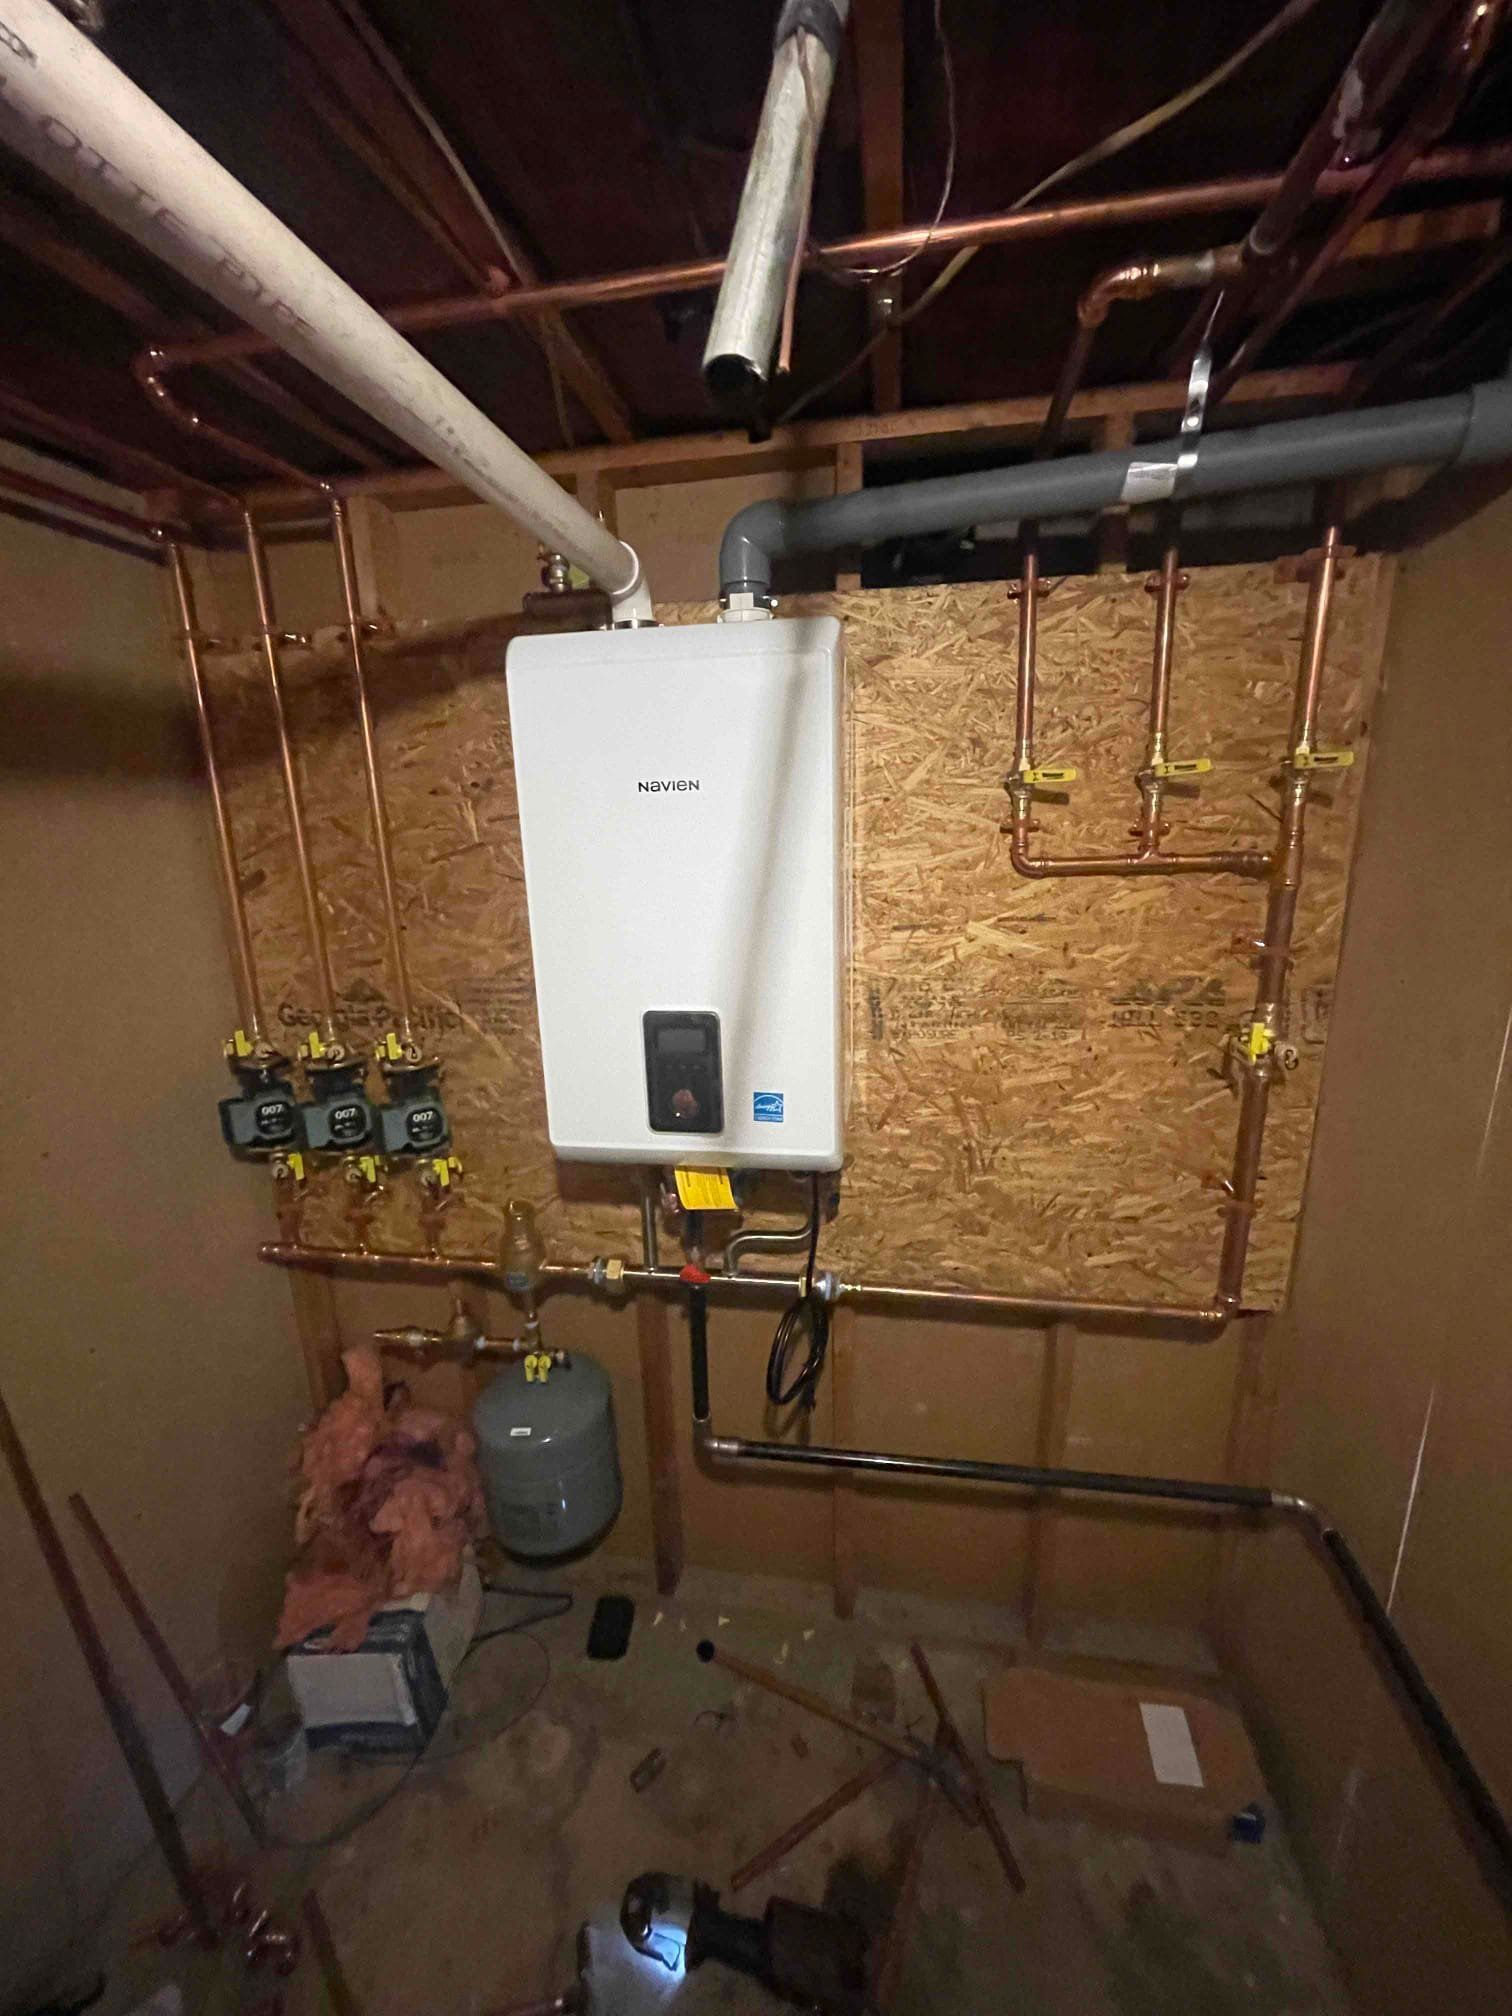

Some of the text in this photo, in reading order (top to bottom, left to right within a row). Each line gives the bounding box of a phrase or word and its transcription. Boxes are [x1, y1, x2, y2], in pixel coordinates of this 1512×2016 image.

[261, 1104, 283, 1116] 007
[335, 1108, 356, 1119] 007
[412, 1111, 433, 1122] 007
